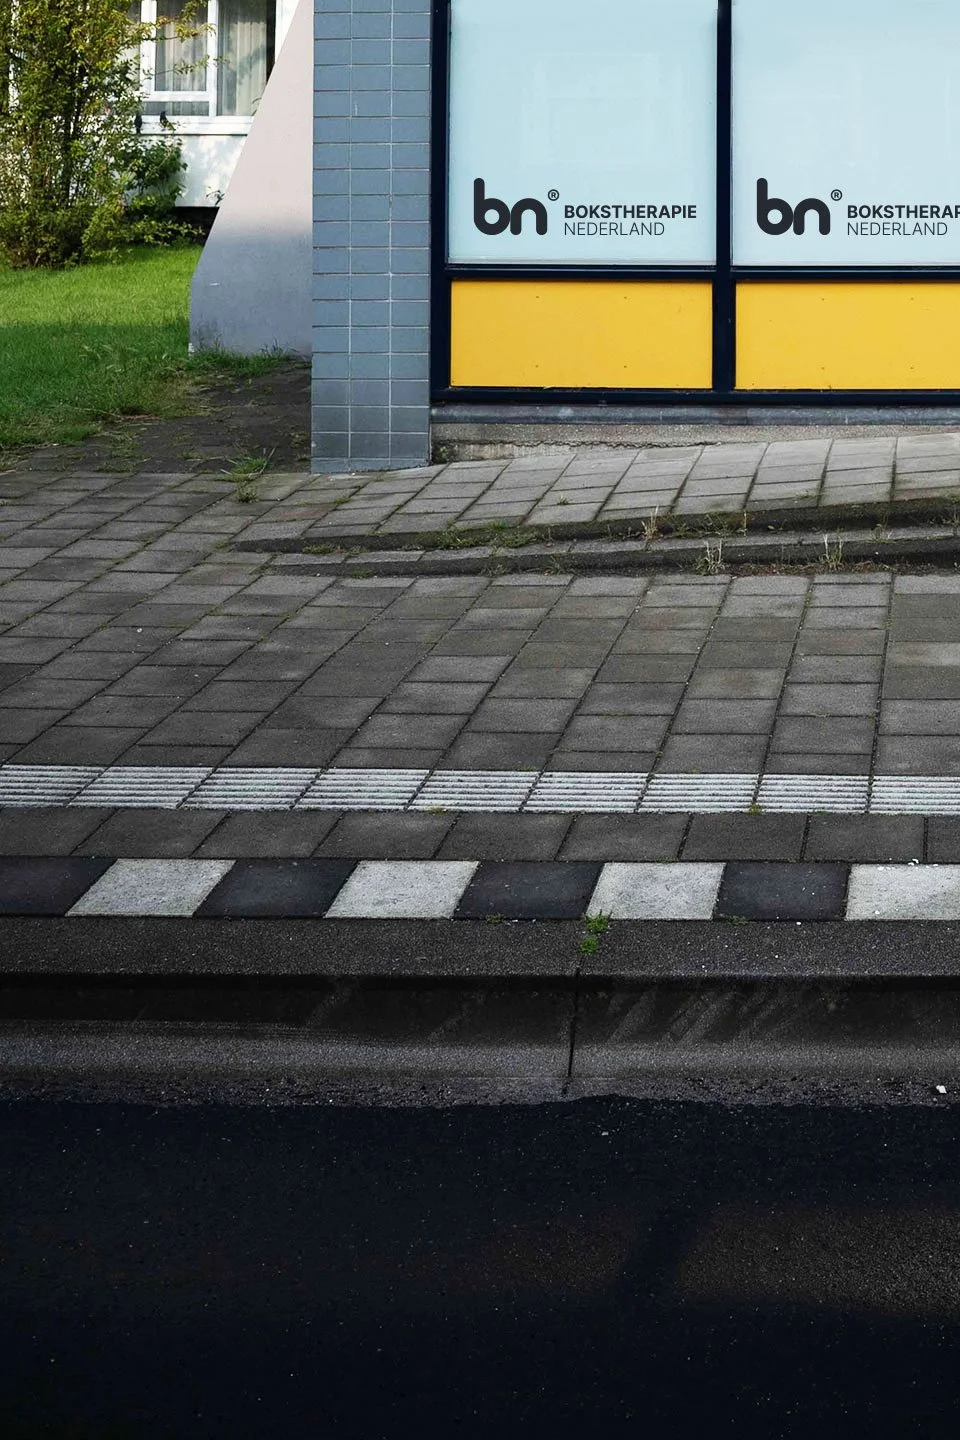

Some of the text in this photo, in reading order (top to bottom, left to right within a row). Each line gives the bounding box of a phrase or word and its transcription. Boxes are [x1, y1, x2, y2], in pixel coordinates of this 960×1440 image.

[564, 204, 697, 219] BOKSTHERAPIE
[564, 221, 665, 236] NEDERLAND
[847, 221, 948, 236] NEDERLAND
